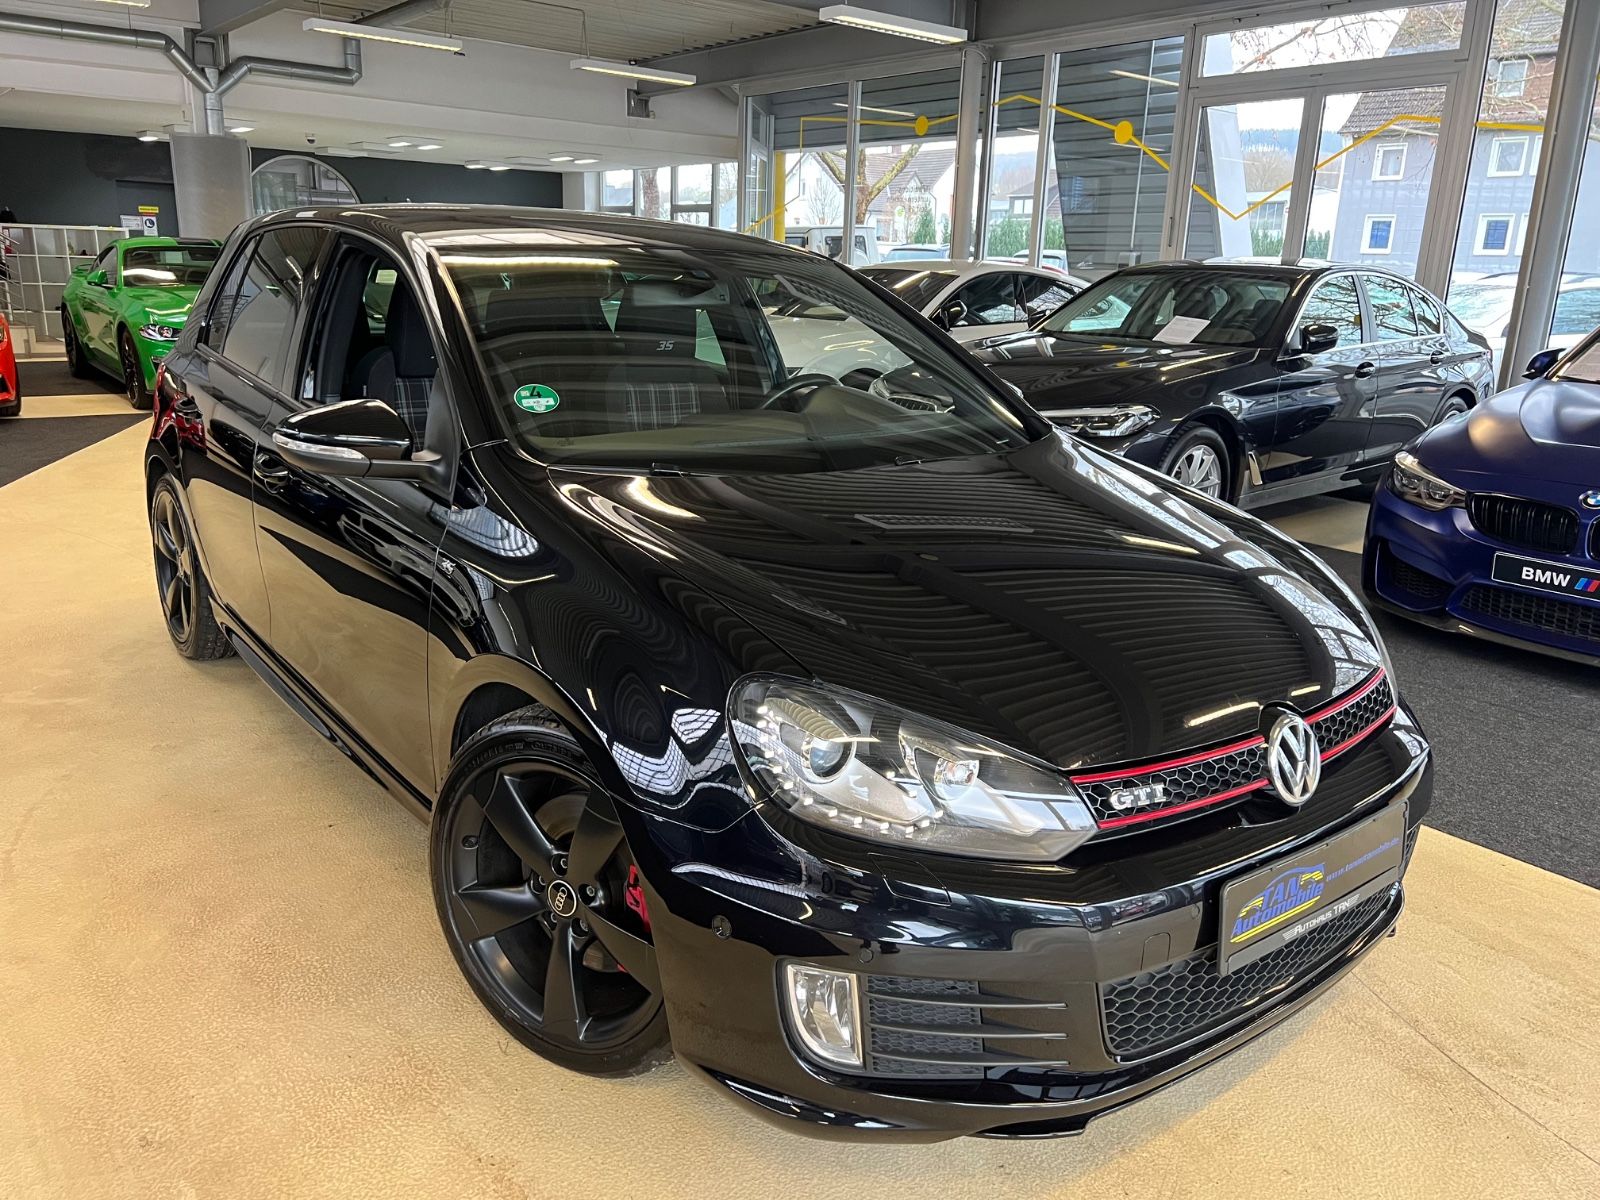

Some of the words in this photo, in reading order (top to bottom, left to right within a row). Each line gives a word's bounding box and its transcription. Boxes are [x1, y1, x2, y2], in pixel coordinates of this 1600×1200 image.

[655, 340, 675, 351] 35
[530, 386, 542, 398] 4
[1521, 566, 1571, 588] BMW
[1110, 782, 1167, 811] GTI
[1261, 874, 1301, 911] TAN
[1231, 882, 1324, 940] Automobile
[1333, 899, 1350, 915] TAN
